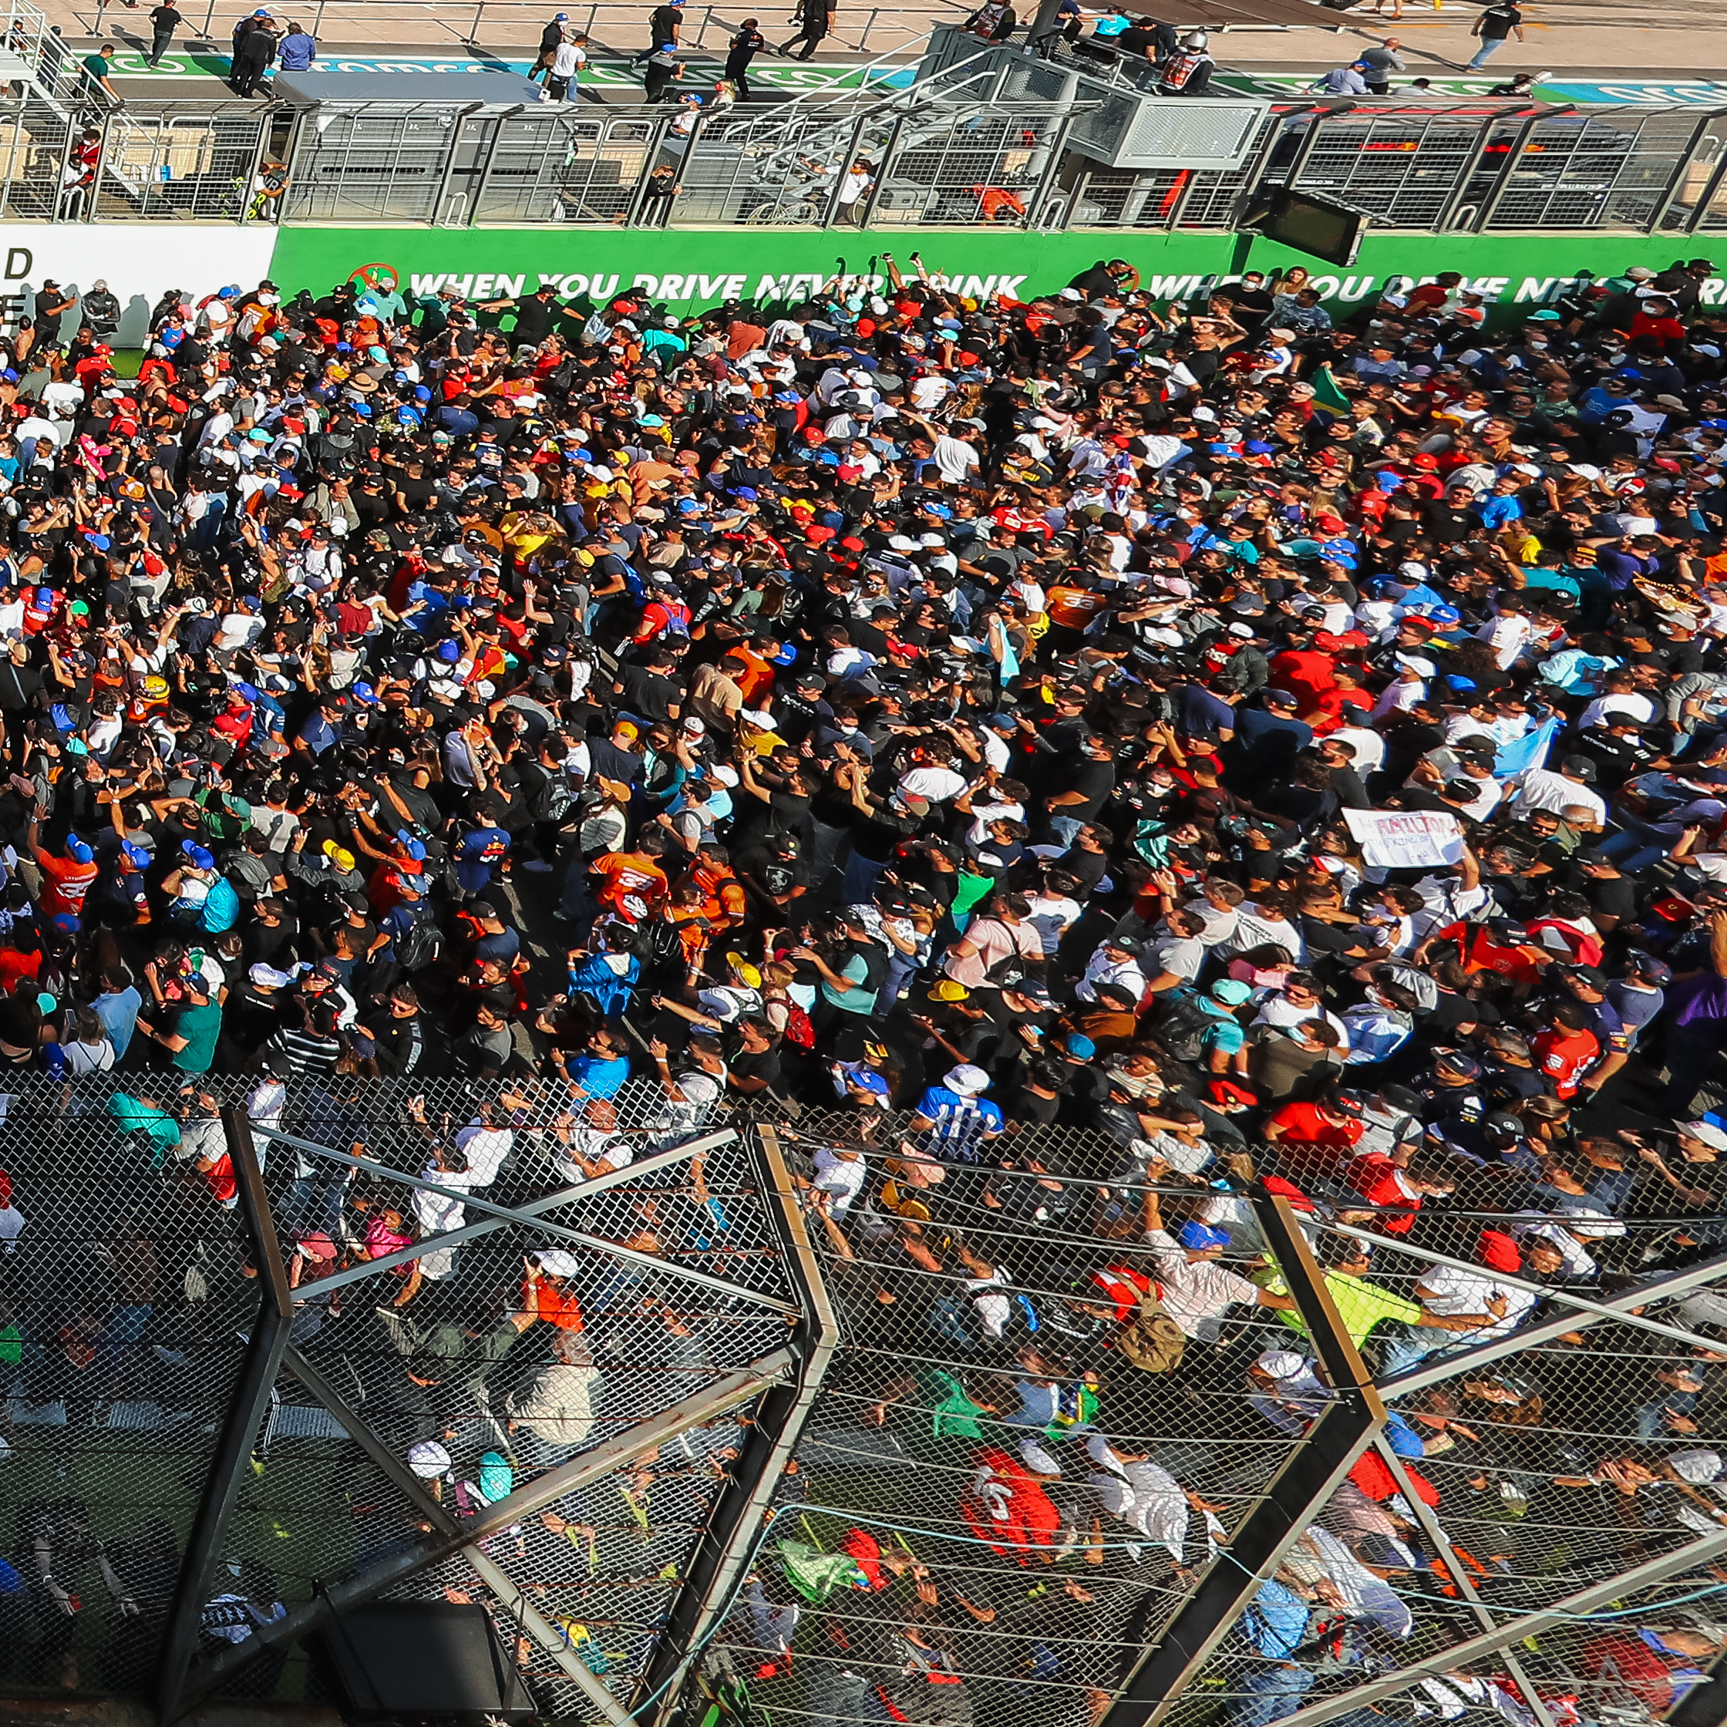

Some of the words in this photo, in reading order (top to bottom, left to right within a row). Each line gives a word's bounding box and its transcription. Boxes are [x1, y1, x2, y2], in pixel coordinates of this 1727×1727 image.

[410, 273, 525, 299] WHEN
[536, 274, 623, 299] YOU
[633, 274, 748, 300] DRIVE
[754, 274, 882, 300] NEVER
[1064, 599, 1095, 609] 33
